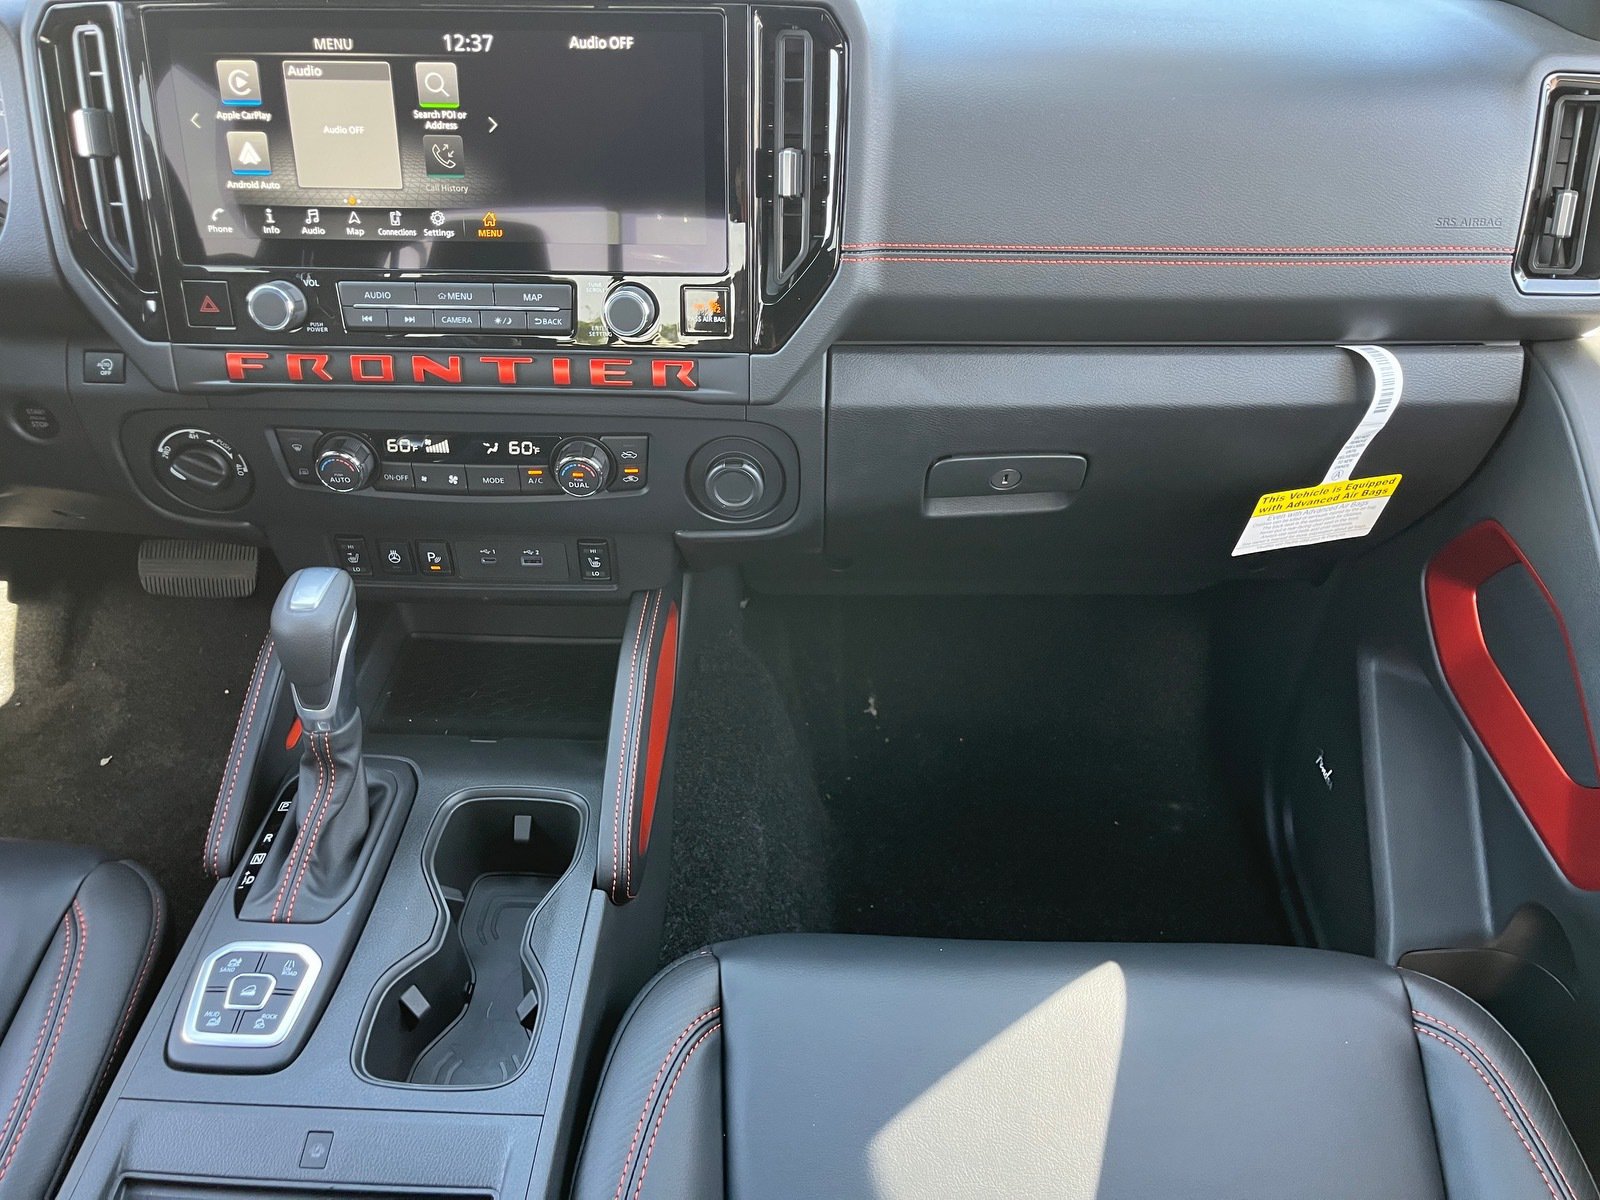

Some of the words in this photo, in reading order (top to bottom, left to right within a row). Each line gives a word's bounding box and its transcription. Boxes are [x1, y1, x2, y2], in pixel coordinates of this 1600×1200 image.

[313, 37, 353, 51] MENU
[443, 34, 494, 52] 12:37
[569, 35, 607, 49] Audio
[609, 36, 634, 49] OFF
[287, 65, 323, 77] Audio
[216, 111, 241, 122] Apple
[241, 111, 272, 122] CarPlay
[413, 110, 440, 120] Search
[441, 110, 456, 120] POI
[457, 111, 468, 120] or
[323, 125, 347, 134] Audio
[349, 126, 365, 134] OFF
[425, 121, 458, 130] Address
[227, 180, 259, 190] Android
[260, 181, 280, 190] Auto
[426, 184, 440, 193] Call
[441, 184, 469, 195] History
[1435, 217, 1457, 227] SRS
[1460, 217, 1503, 227] AIRBAG
[208, 224, 233, 234] Phone
[263, 225, 280, 235] Info
[301, 226, 326, 236] Audio
[346, 227, 365, 238] Map
[378, 227, 417, 237] Connections
[424, 228, 455, 239] Settings
[478, 229, 503, 238] MENU
[303, 279, 320, 287] VOL
[364, 291, 392, 300] AUDIO
[447, 292, 473, 300] MENU
[523, 293, 543, 302] MAP
[441, 315, 473, 324] CAMERA
[542, 317, 563, 326] BACK
[225, 352, 697, 386] FRONTIER
[216, 438, 232, 452] PUSH
[235, 463, 245, 477] 4LO
[330, 476, 351, 484] AUTO
[383, 473, 410, 482] ON-OFF
[1261, 496, 1286, 505] This
[1289, 488, 1330, 501] Vehicle
[1344, 477, 1397, 492] Equipped
[1259, 503, 1283, 514] with
[1285, 495, 1340, 510] Advanced
[1342, 491, 1359, 499] Air
[1361, 487, 1389, 498] Bags
[1285, 510, 1302, 519] with
[1302, 504, 1339, 517] Advanced
[1338, 503, 1350, 511] Air
[1350, 501, 1370, 509] Bags
[263, 833, 274, 843] R
[246, 875, 255, 884] D
